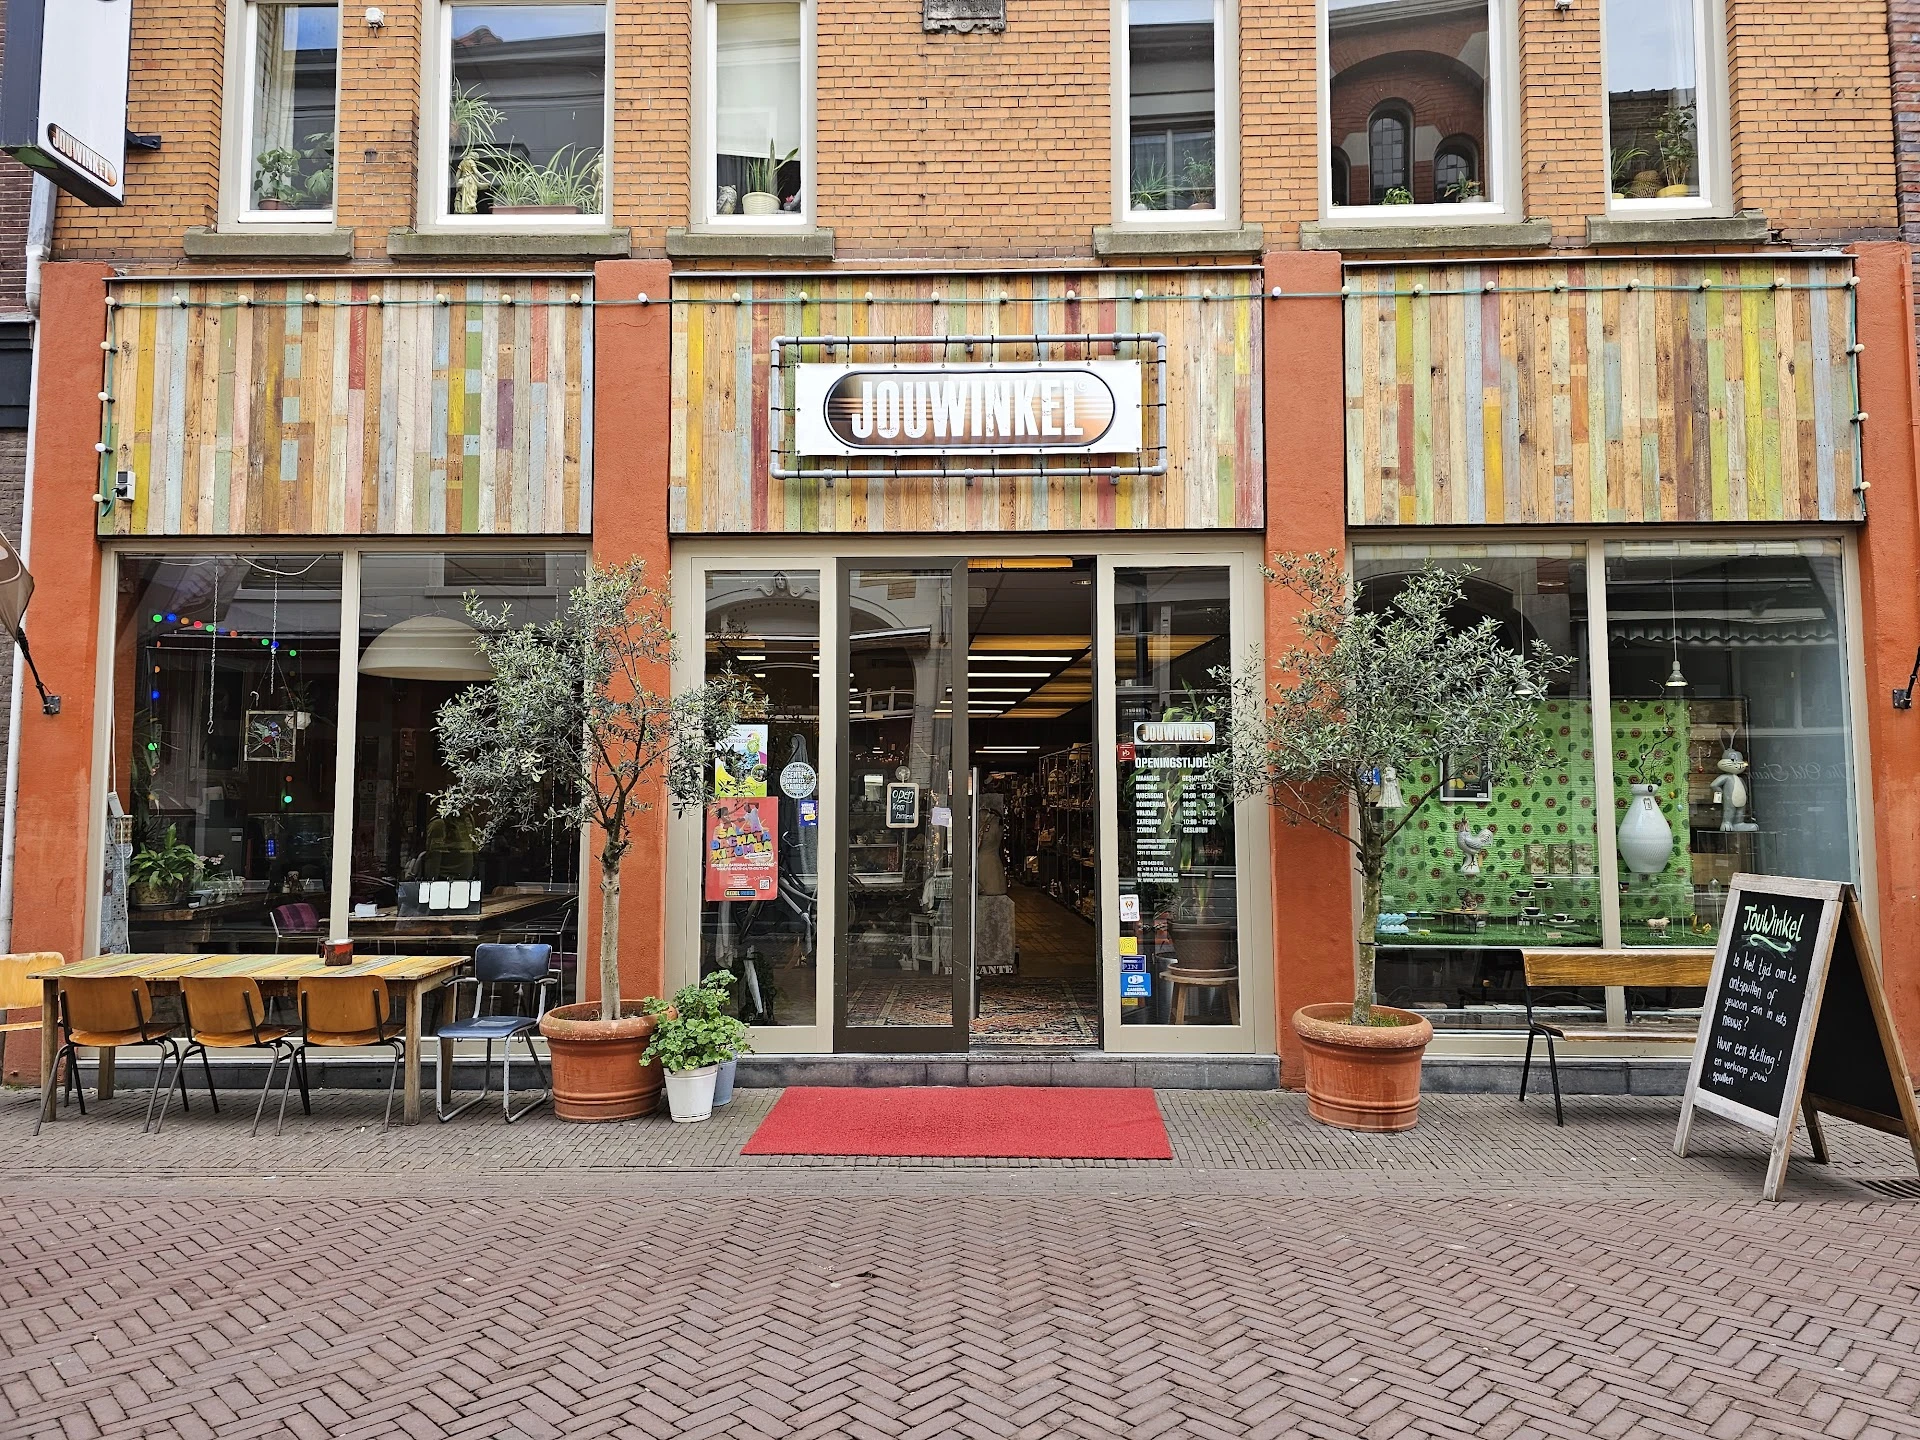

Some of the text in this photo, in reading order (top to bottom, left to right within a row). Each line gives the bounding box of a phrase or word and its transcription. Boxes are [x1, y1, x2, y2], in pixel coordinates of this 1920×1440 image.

[52, 127, 111, 183] JOUWINKEL
[851, 379, 1084, 439] JOUWINKEL
[1142, 725, 1206, 741] JOUWINKEL
[892, 789, 914, 803] open
[710, 832, 771, 850] BACHATA
[717, 823, 763, 839] SALSA
[711, 841, 773, 860] KIZOMBA
[1743, 904, 1804, 942] JouWinkel
[944, 965, 1014, 974] BANTE
[1733, 951, 1797, 984] Is het tijd om te
[1728, 976, 1778, 1004] ontspullen of
[1724, 998, 1788, 1027] gewoon zin in iets
[1716, 1035, 1732, 1053] Huur
[1734, 1046, 1747, 1058] een
[1712, 1071, 1735, 1086] spullen
[1713, 1057, 1768, 1083] en verkoop jouw
